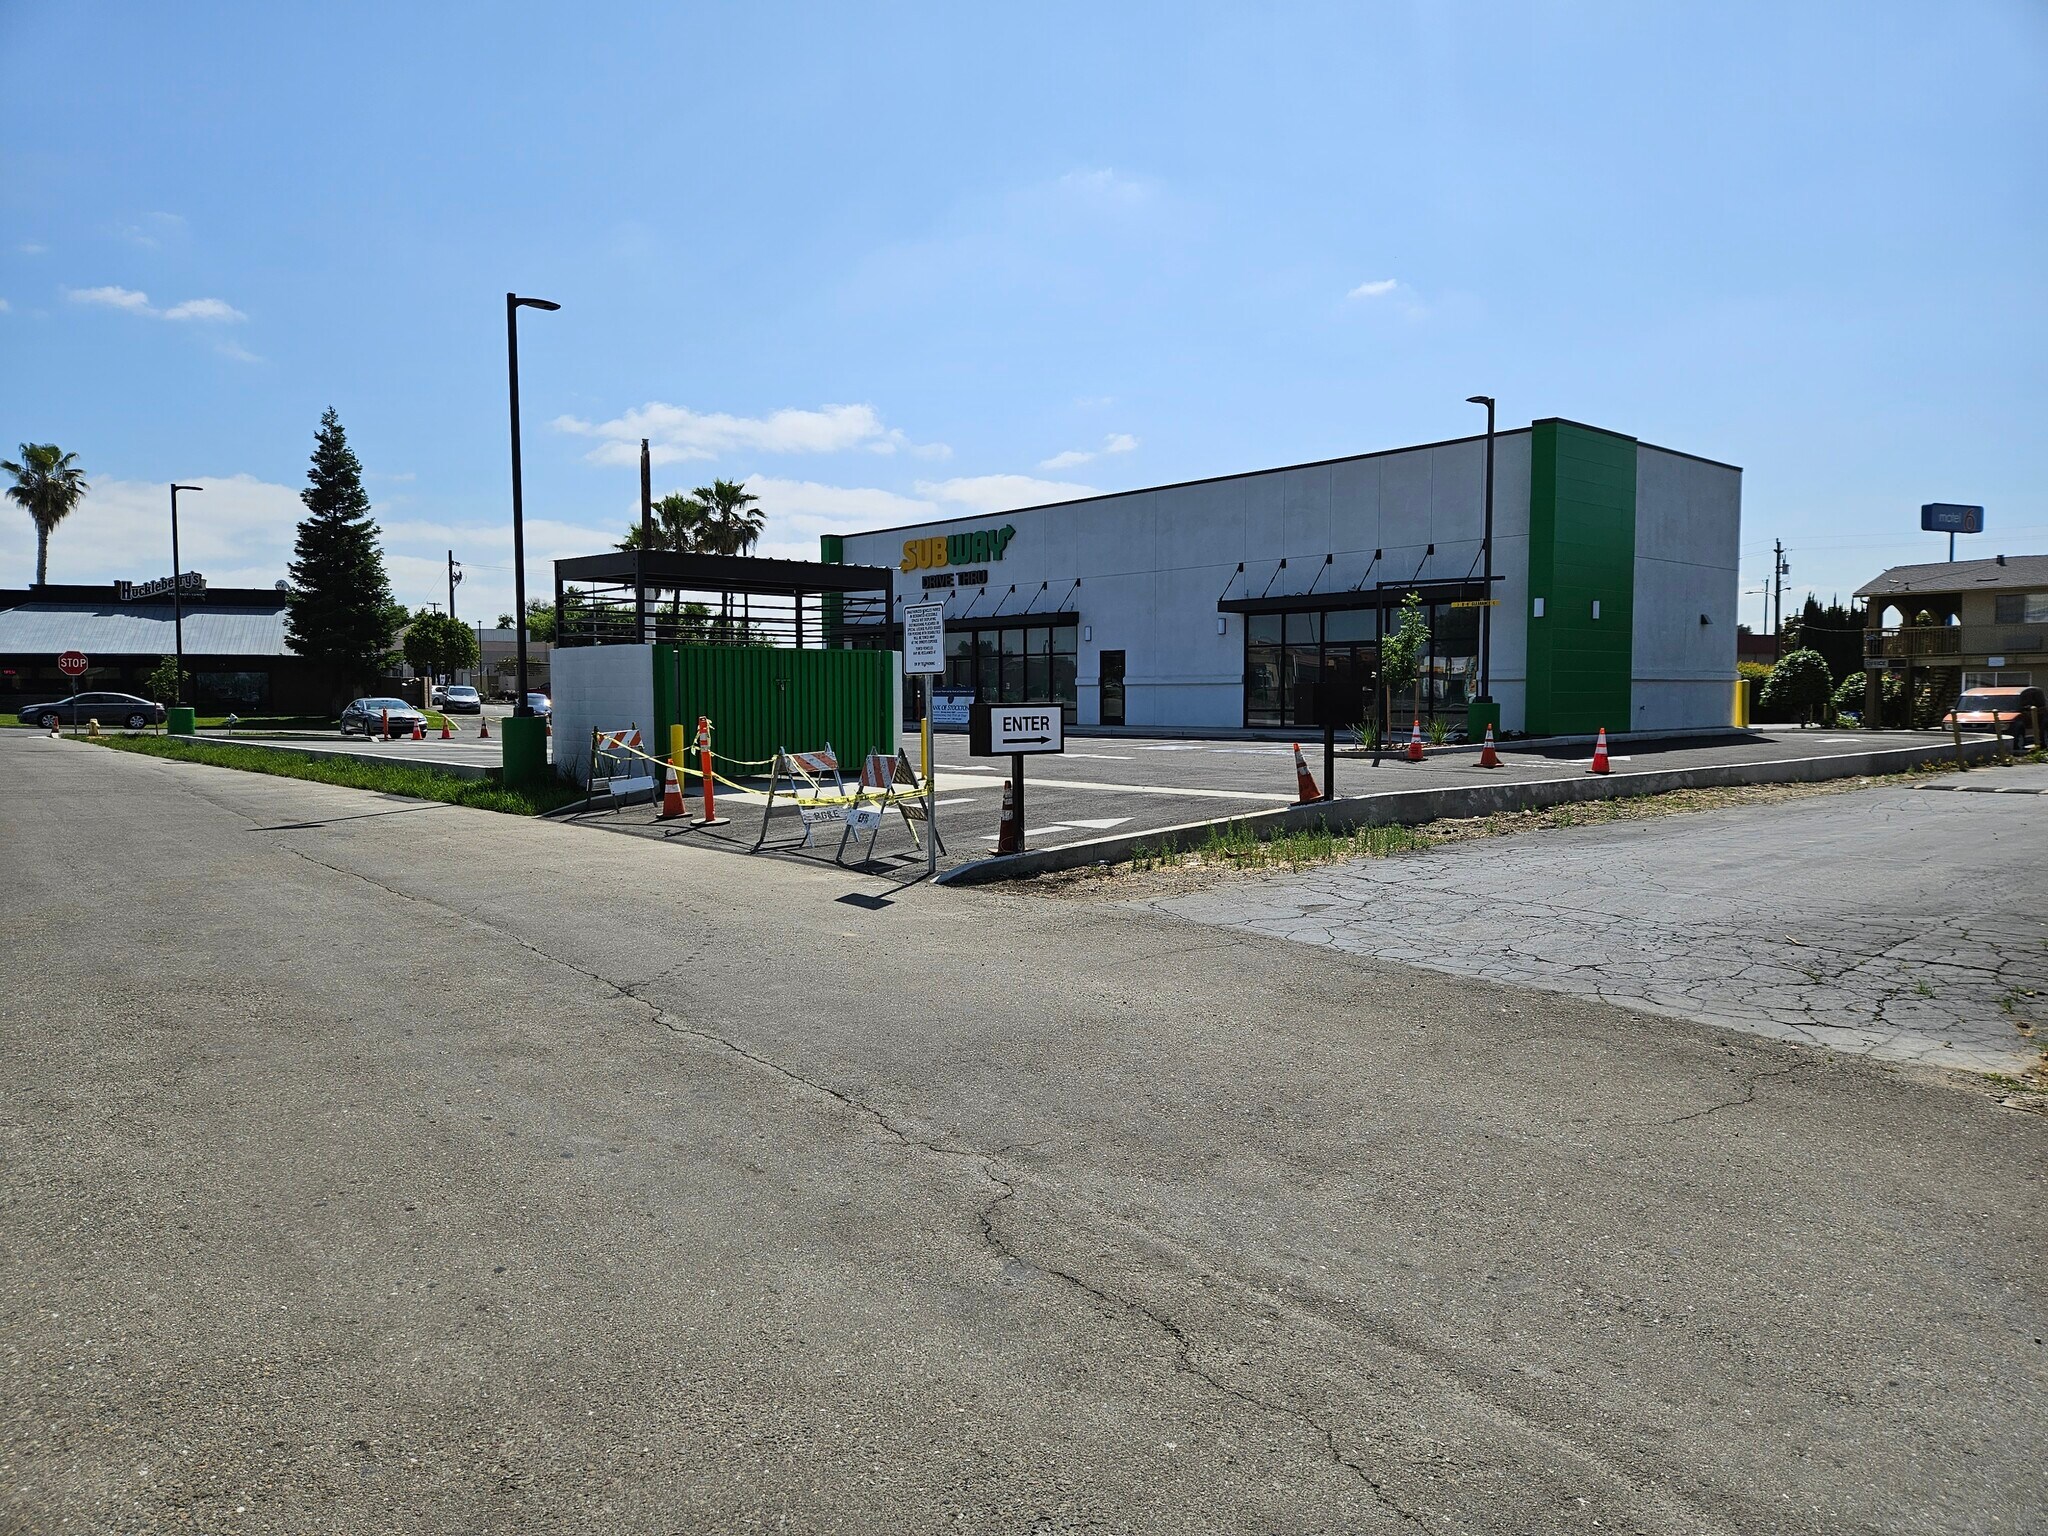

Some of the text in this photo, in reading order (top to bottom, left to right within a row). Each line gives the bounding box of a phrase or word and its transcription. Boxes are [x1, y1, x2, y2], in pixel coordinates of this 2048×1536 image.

[1964, 508, 1976, 532] 6
[900, 524, 1016, 573] SUBWAY
[922, 569, 988, 589] DRIVE THRU
[60, 658, 87, 668] STOP
[1003, 715, 1050, 732] ENTER
